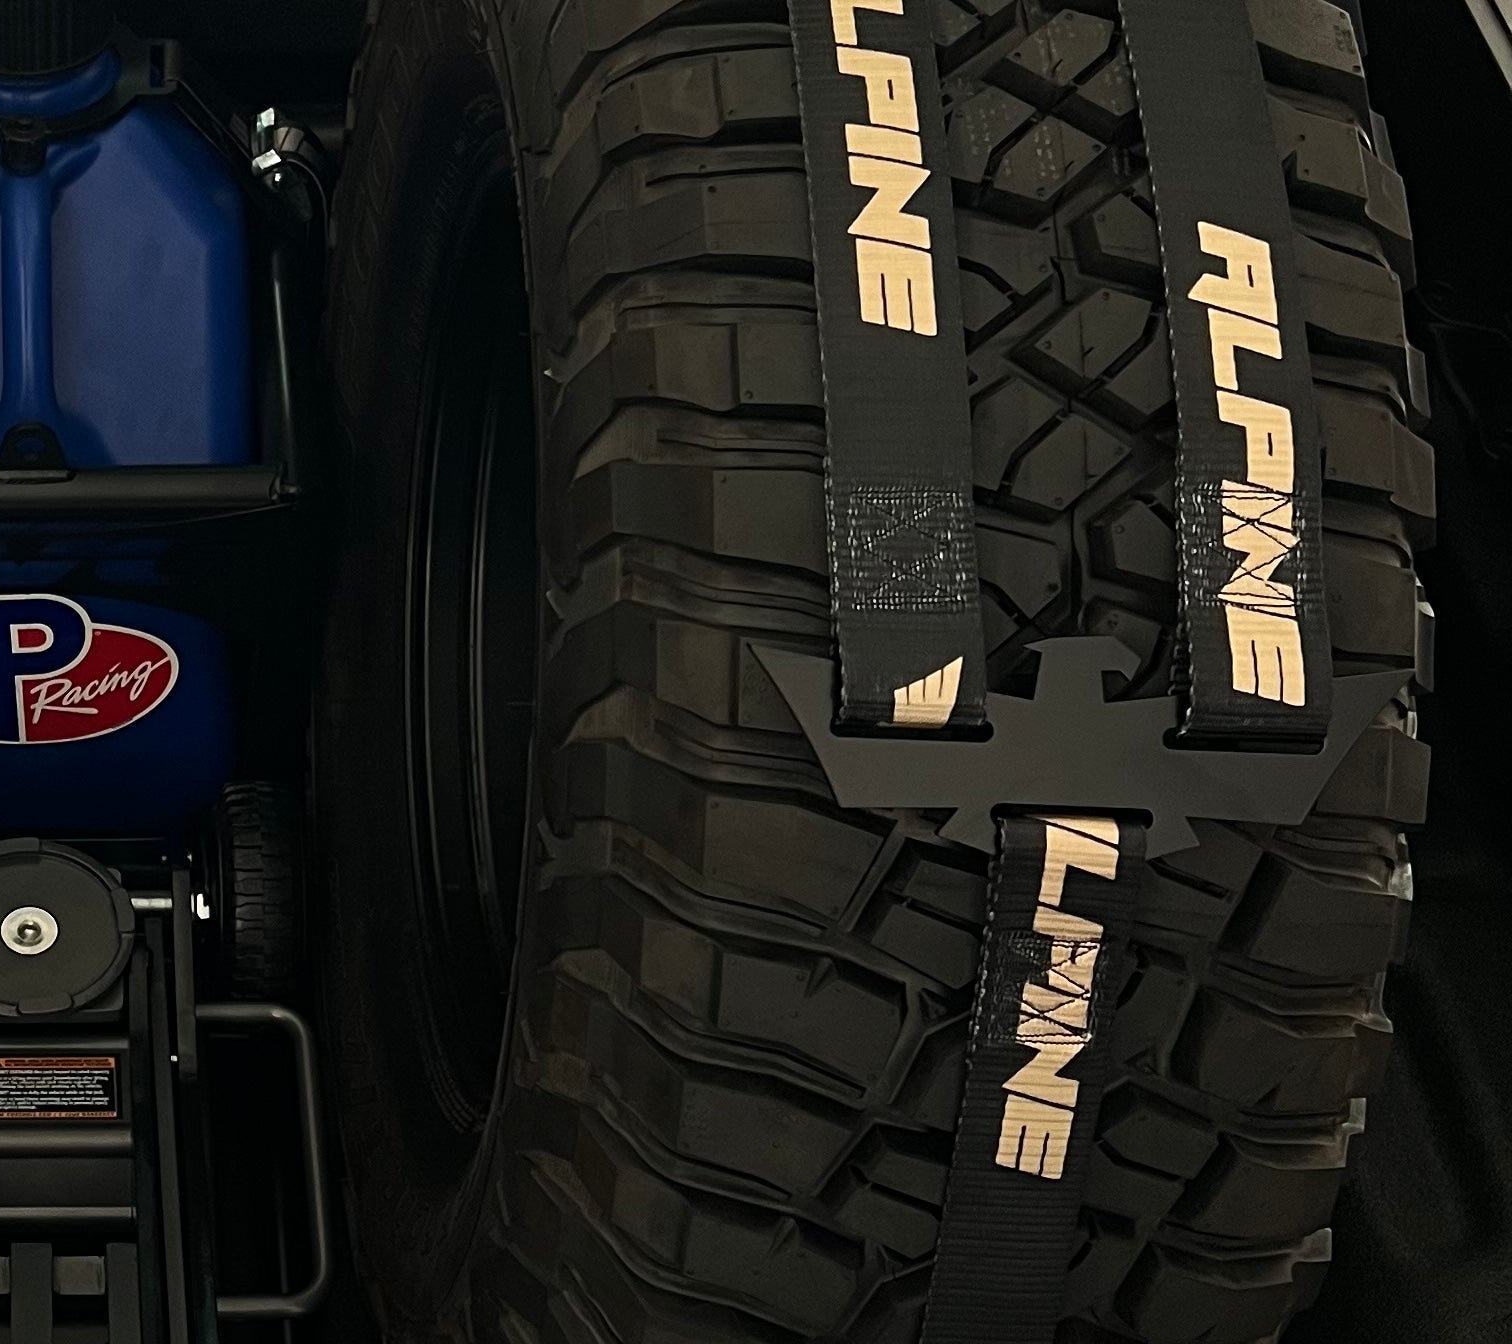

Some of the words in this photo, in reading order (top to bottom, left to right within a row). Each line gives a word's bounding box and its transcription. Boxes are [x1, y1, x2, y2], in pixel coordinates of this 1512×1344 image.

[1187, 220, 1306, 707] ALPINE
[30, 657, 160, 724] Racing
[995, 816, 1120, 1180] LPINE
